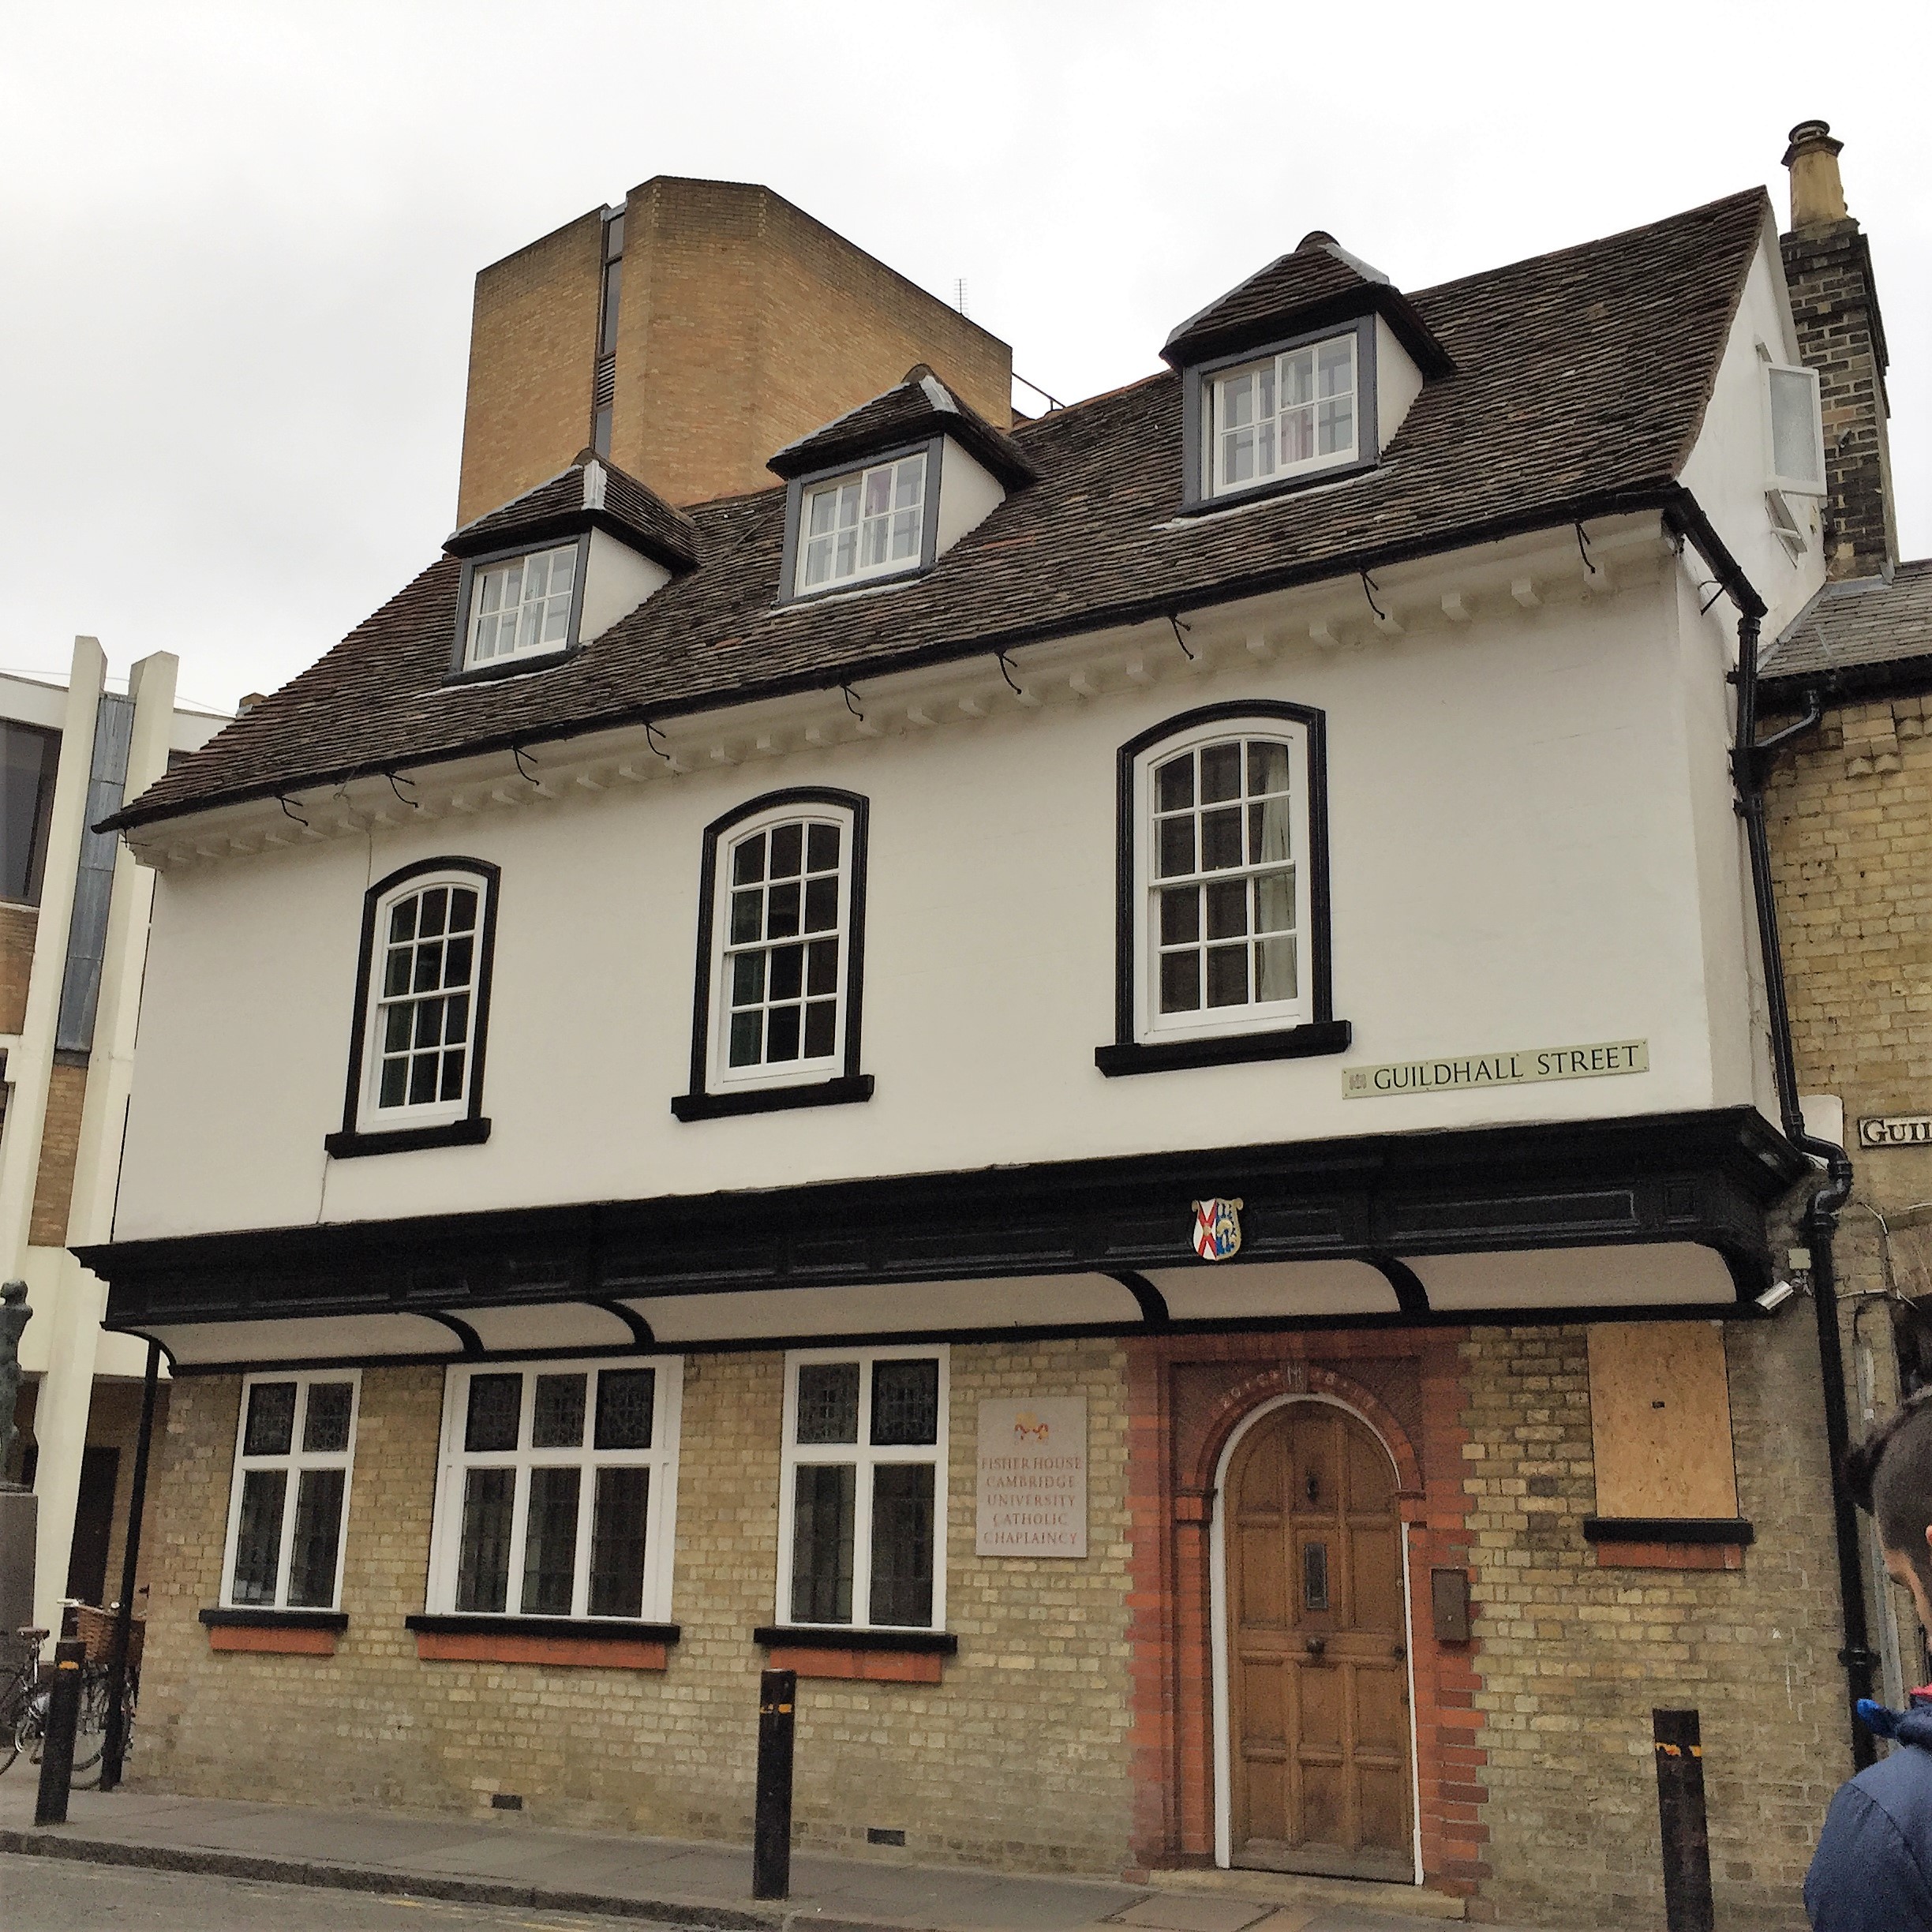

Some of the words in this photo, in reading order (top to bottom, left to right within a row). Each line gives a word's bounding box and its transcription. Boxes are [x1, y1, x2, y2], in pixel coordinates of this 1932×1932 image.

[1374, 1058, 1523, 1090] GUILDHALL
[1537, 1045, 1639, 1076] STREET
[981, 1457, 1029, 1470] FISHER
[1033, 1457, 1081, 1470] HOUSE
[987, 1475, 1075, 1488] CAMBRIDGE
[987, 1494, 1075, 1507] UNIVERSITY
[993, 1513, 1068, 1526] CATHOLIC
[983, 1531, 1076, 1544] CHAPLAINCY
